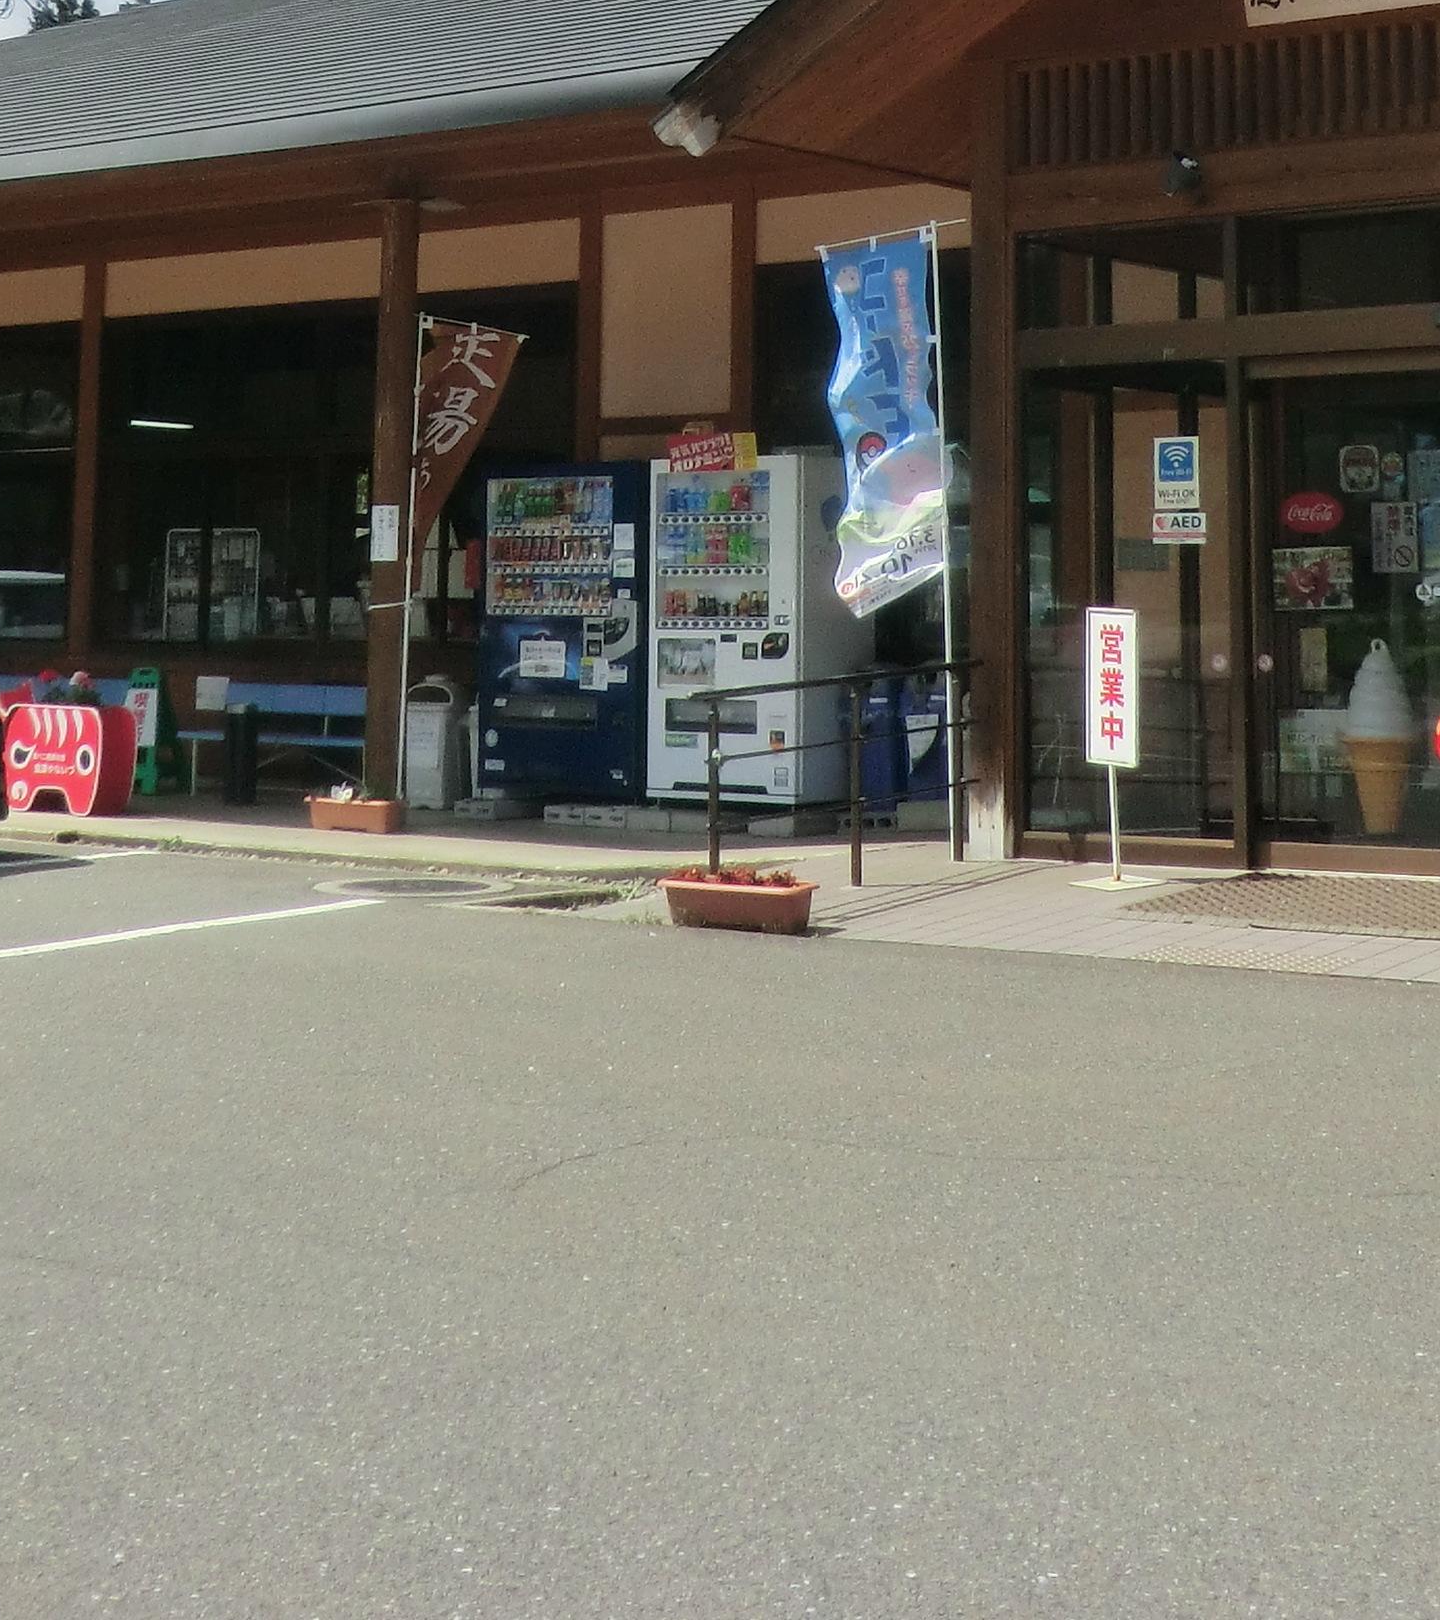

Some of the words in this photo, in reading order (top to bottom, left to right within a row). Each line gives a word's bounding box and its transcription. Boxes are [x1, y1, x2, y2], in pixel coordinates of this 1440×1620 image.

[1170, 516, 1202, 529] AED
[1098, 623, 1126, 751] 営業中
